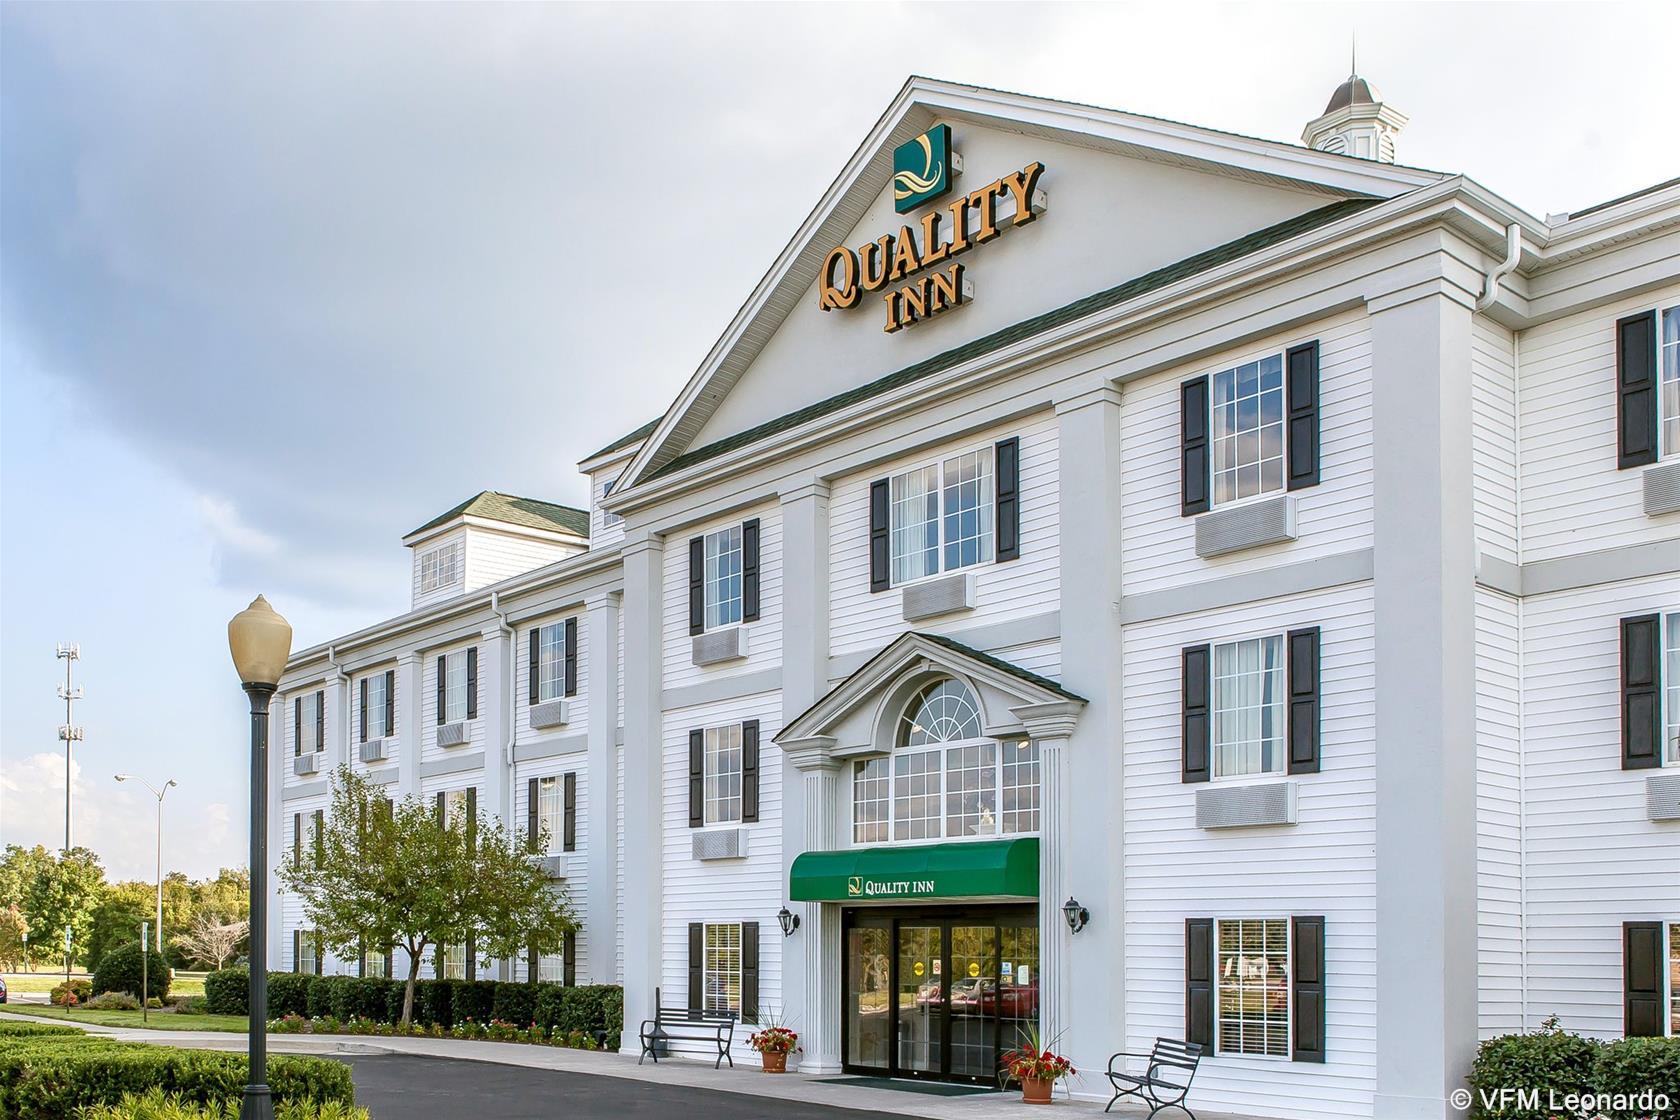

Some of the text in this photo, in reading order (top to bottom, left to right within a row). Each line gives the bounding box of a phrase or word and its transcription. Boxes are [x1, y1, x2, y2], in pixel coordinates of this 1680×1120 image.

[819, 161, 1045, 312] QUALITY
[884, 263, 965, 333] INN
[865, 880, 934, 895] QUALITY INN
